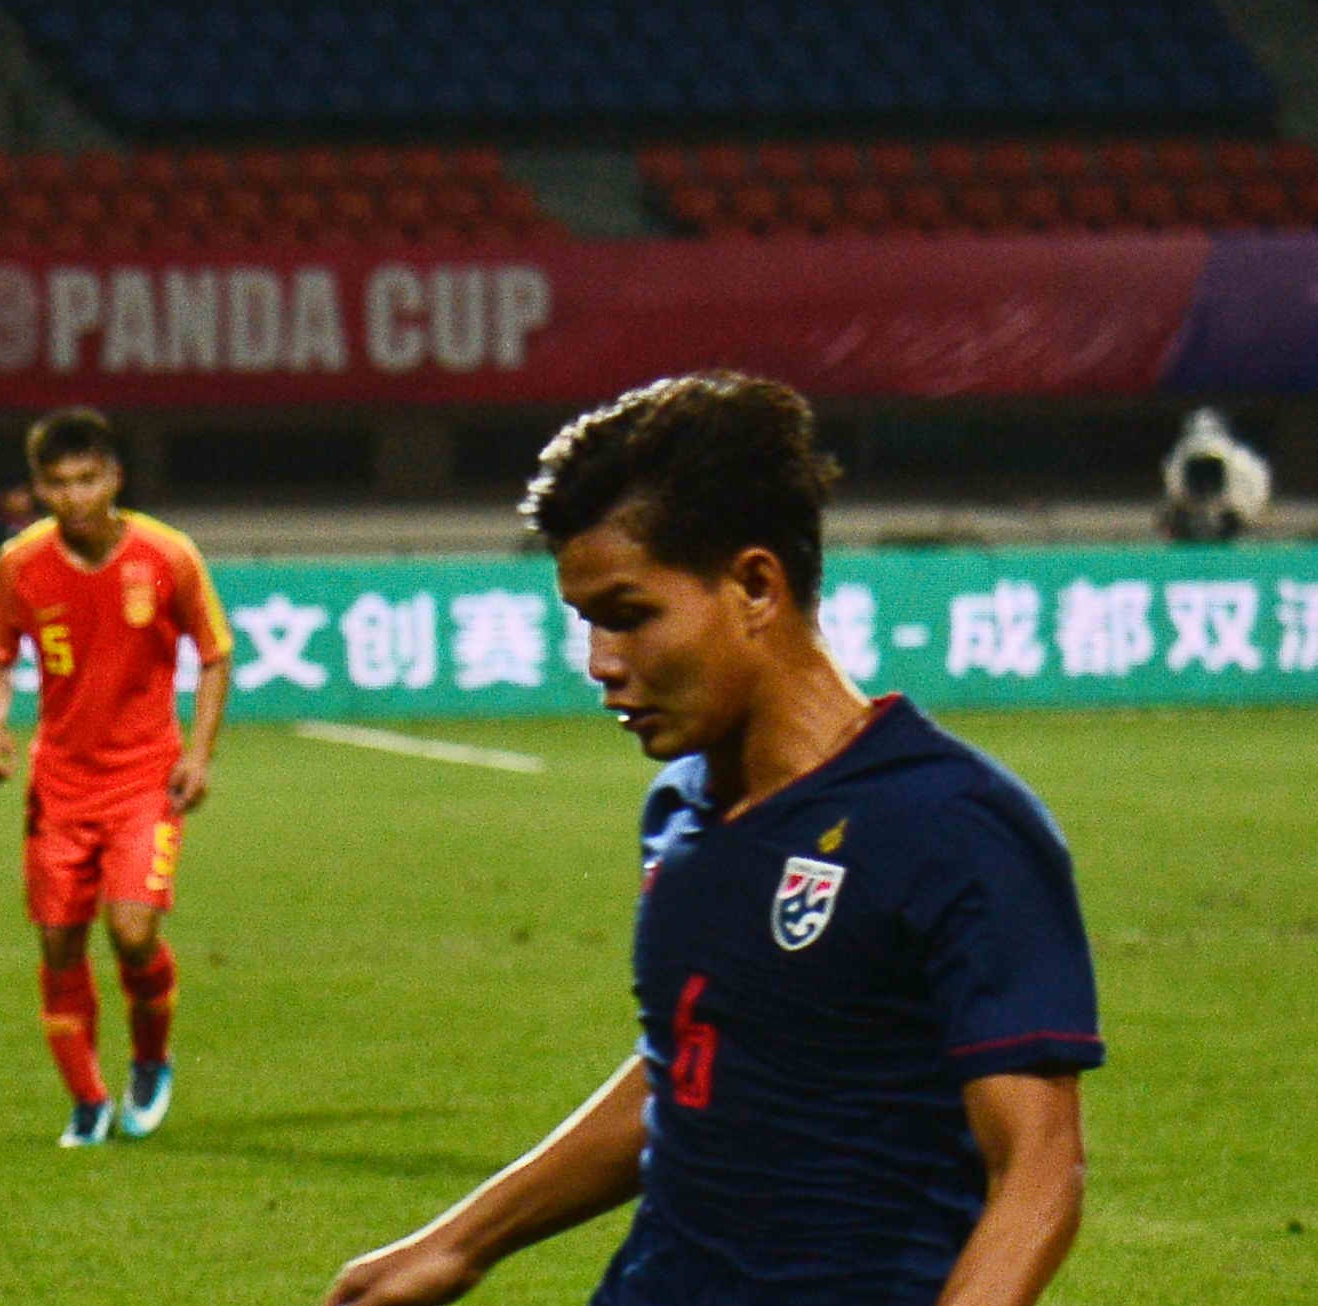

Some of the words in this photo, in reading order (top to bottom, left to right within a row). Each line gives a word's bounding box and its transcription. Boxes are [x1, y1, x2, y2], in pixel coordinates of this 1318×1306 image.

[364, 265, 552, 373] CUP
[41, 624, 75, 676] 5
[672, 975, 719, 1109] 6
